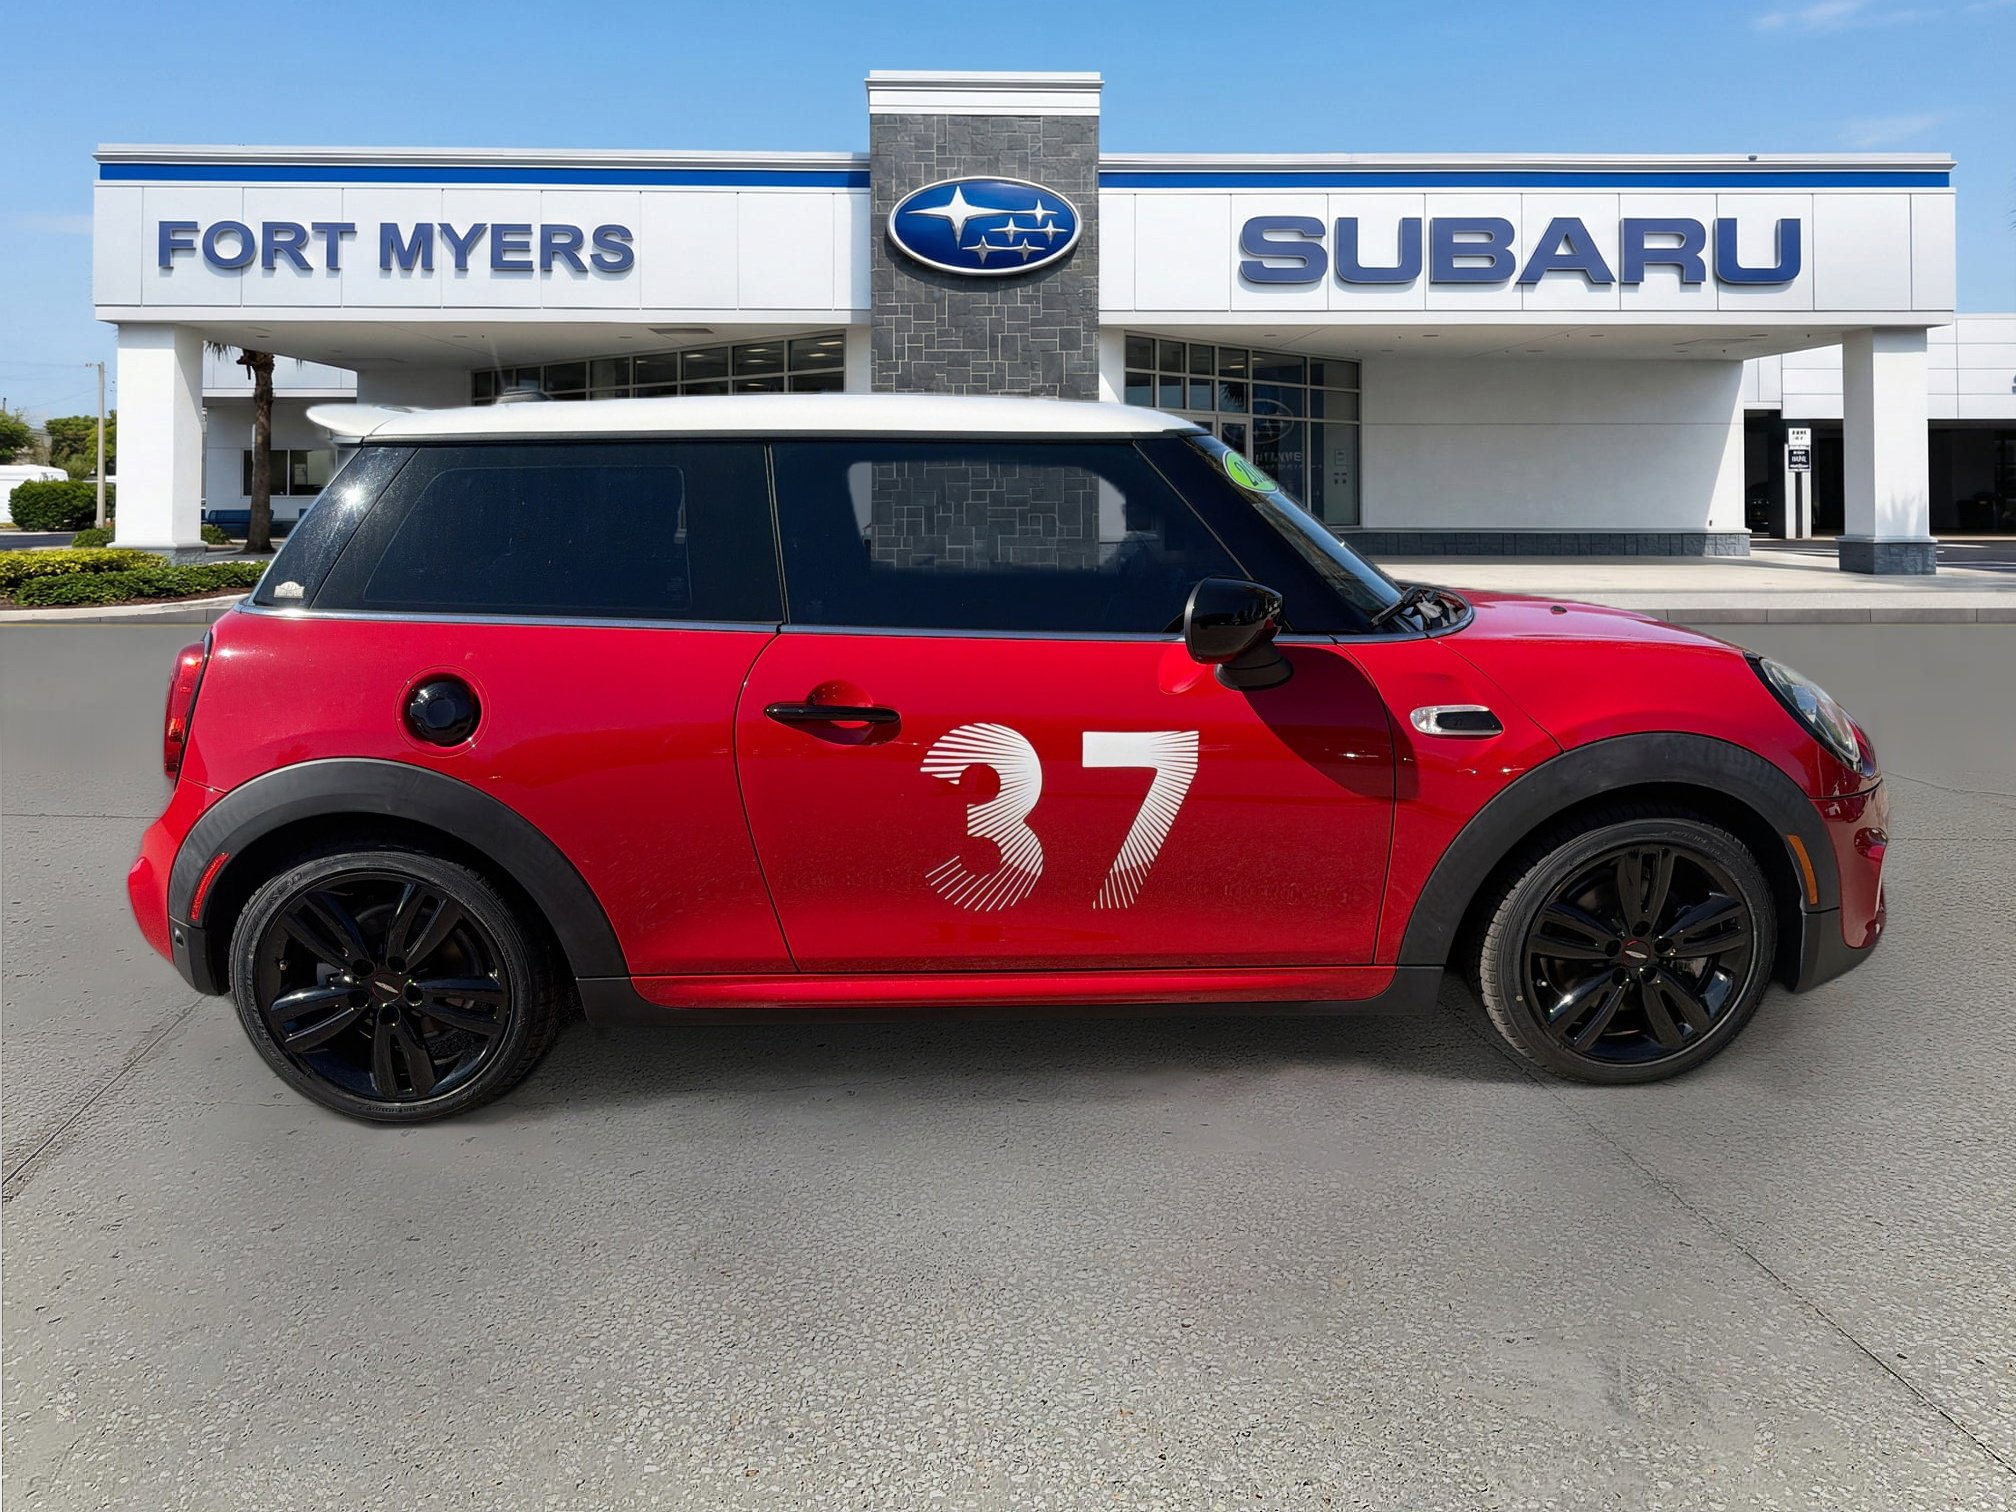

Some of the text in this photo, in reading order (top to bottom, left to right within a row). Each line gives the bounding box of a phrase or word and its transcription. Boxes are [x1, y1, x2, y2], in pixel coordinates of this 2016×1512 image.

[158, 220, 635, 273] FORT MYERS
[1239, 215, 1802, 285] SUBARU
[920, 722, 1200, 912] 37
